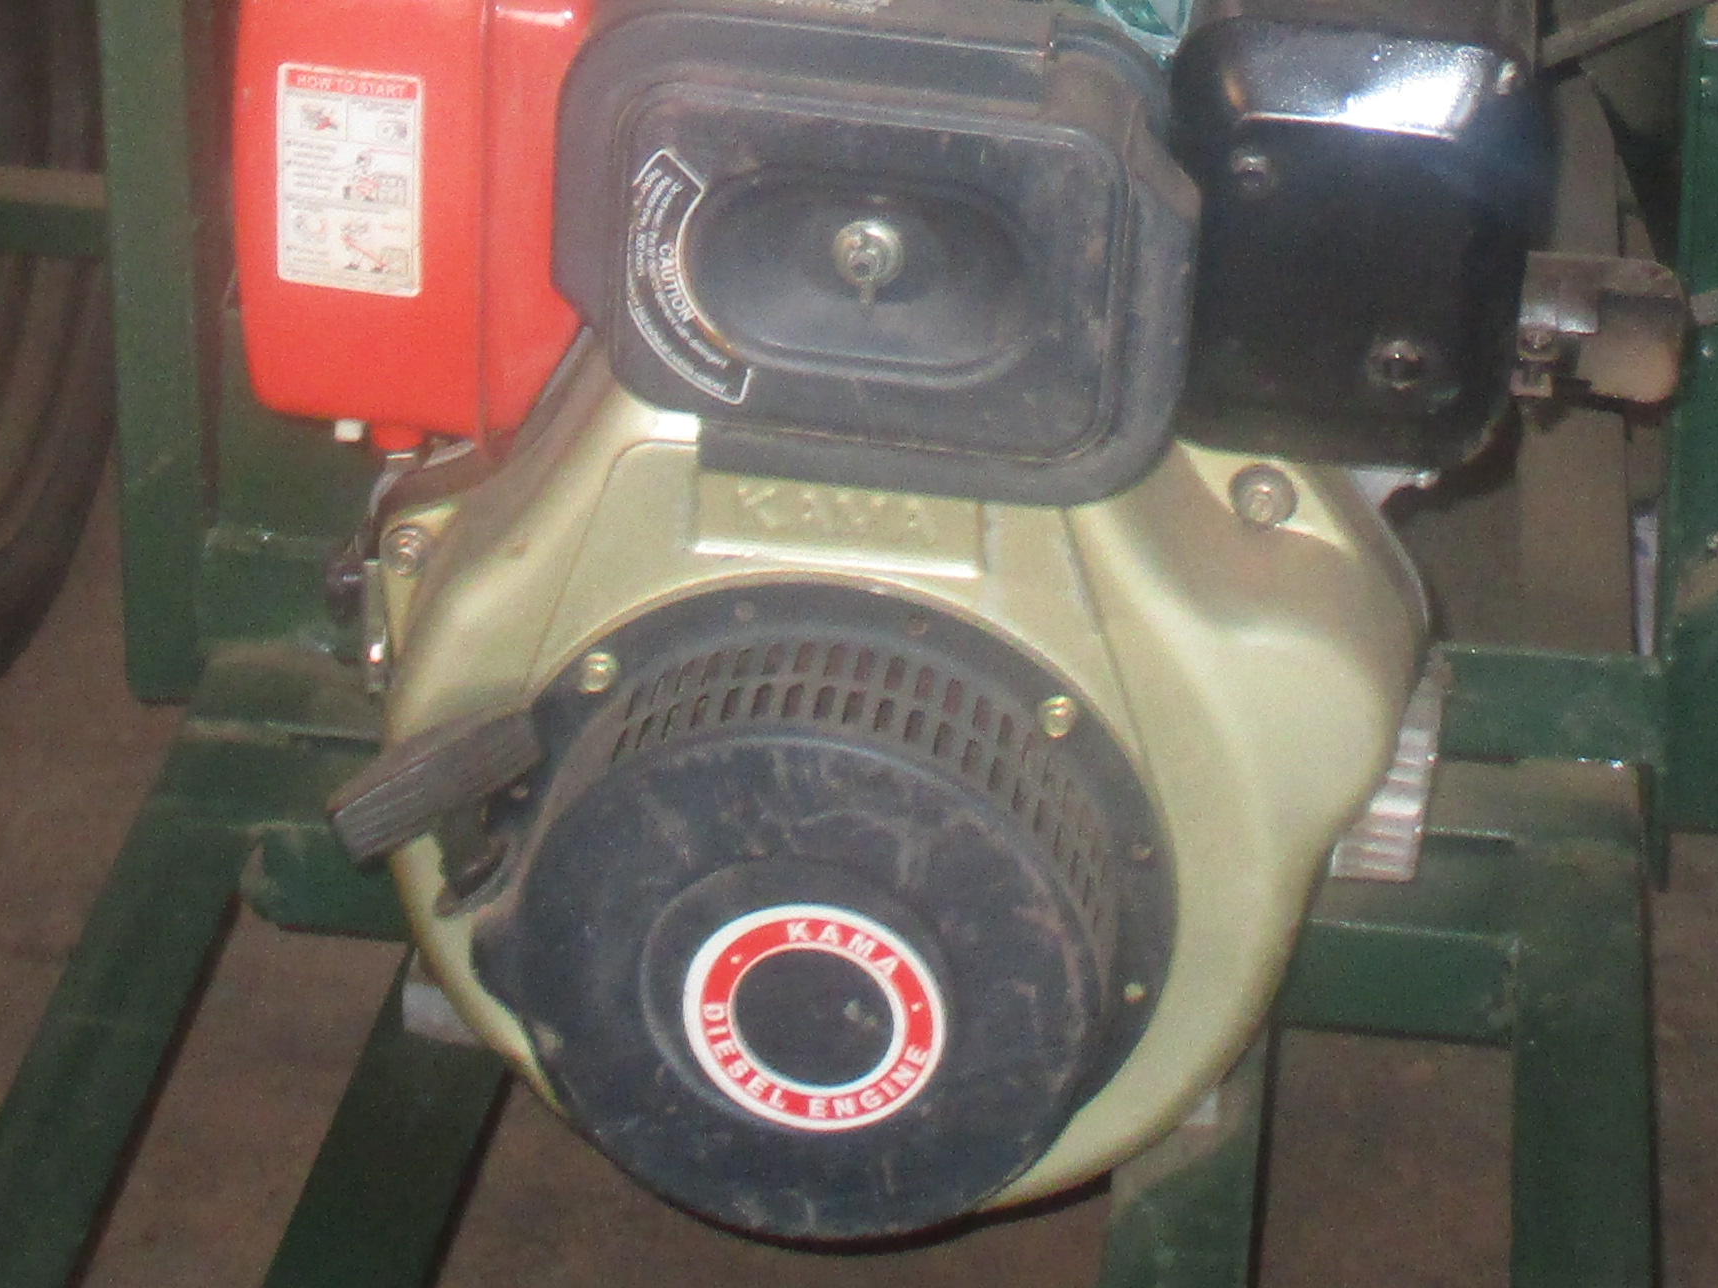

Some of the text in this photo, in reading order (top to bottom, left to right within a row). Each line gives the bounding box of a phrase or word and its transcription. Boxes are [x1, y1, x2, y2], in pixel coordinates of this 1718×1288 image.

[659, 241, 696, 323] CAUTION
[786, 921, 899, 978] KAMA
[701, 1001, 929, 1120] DIESEL ENGINE
